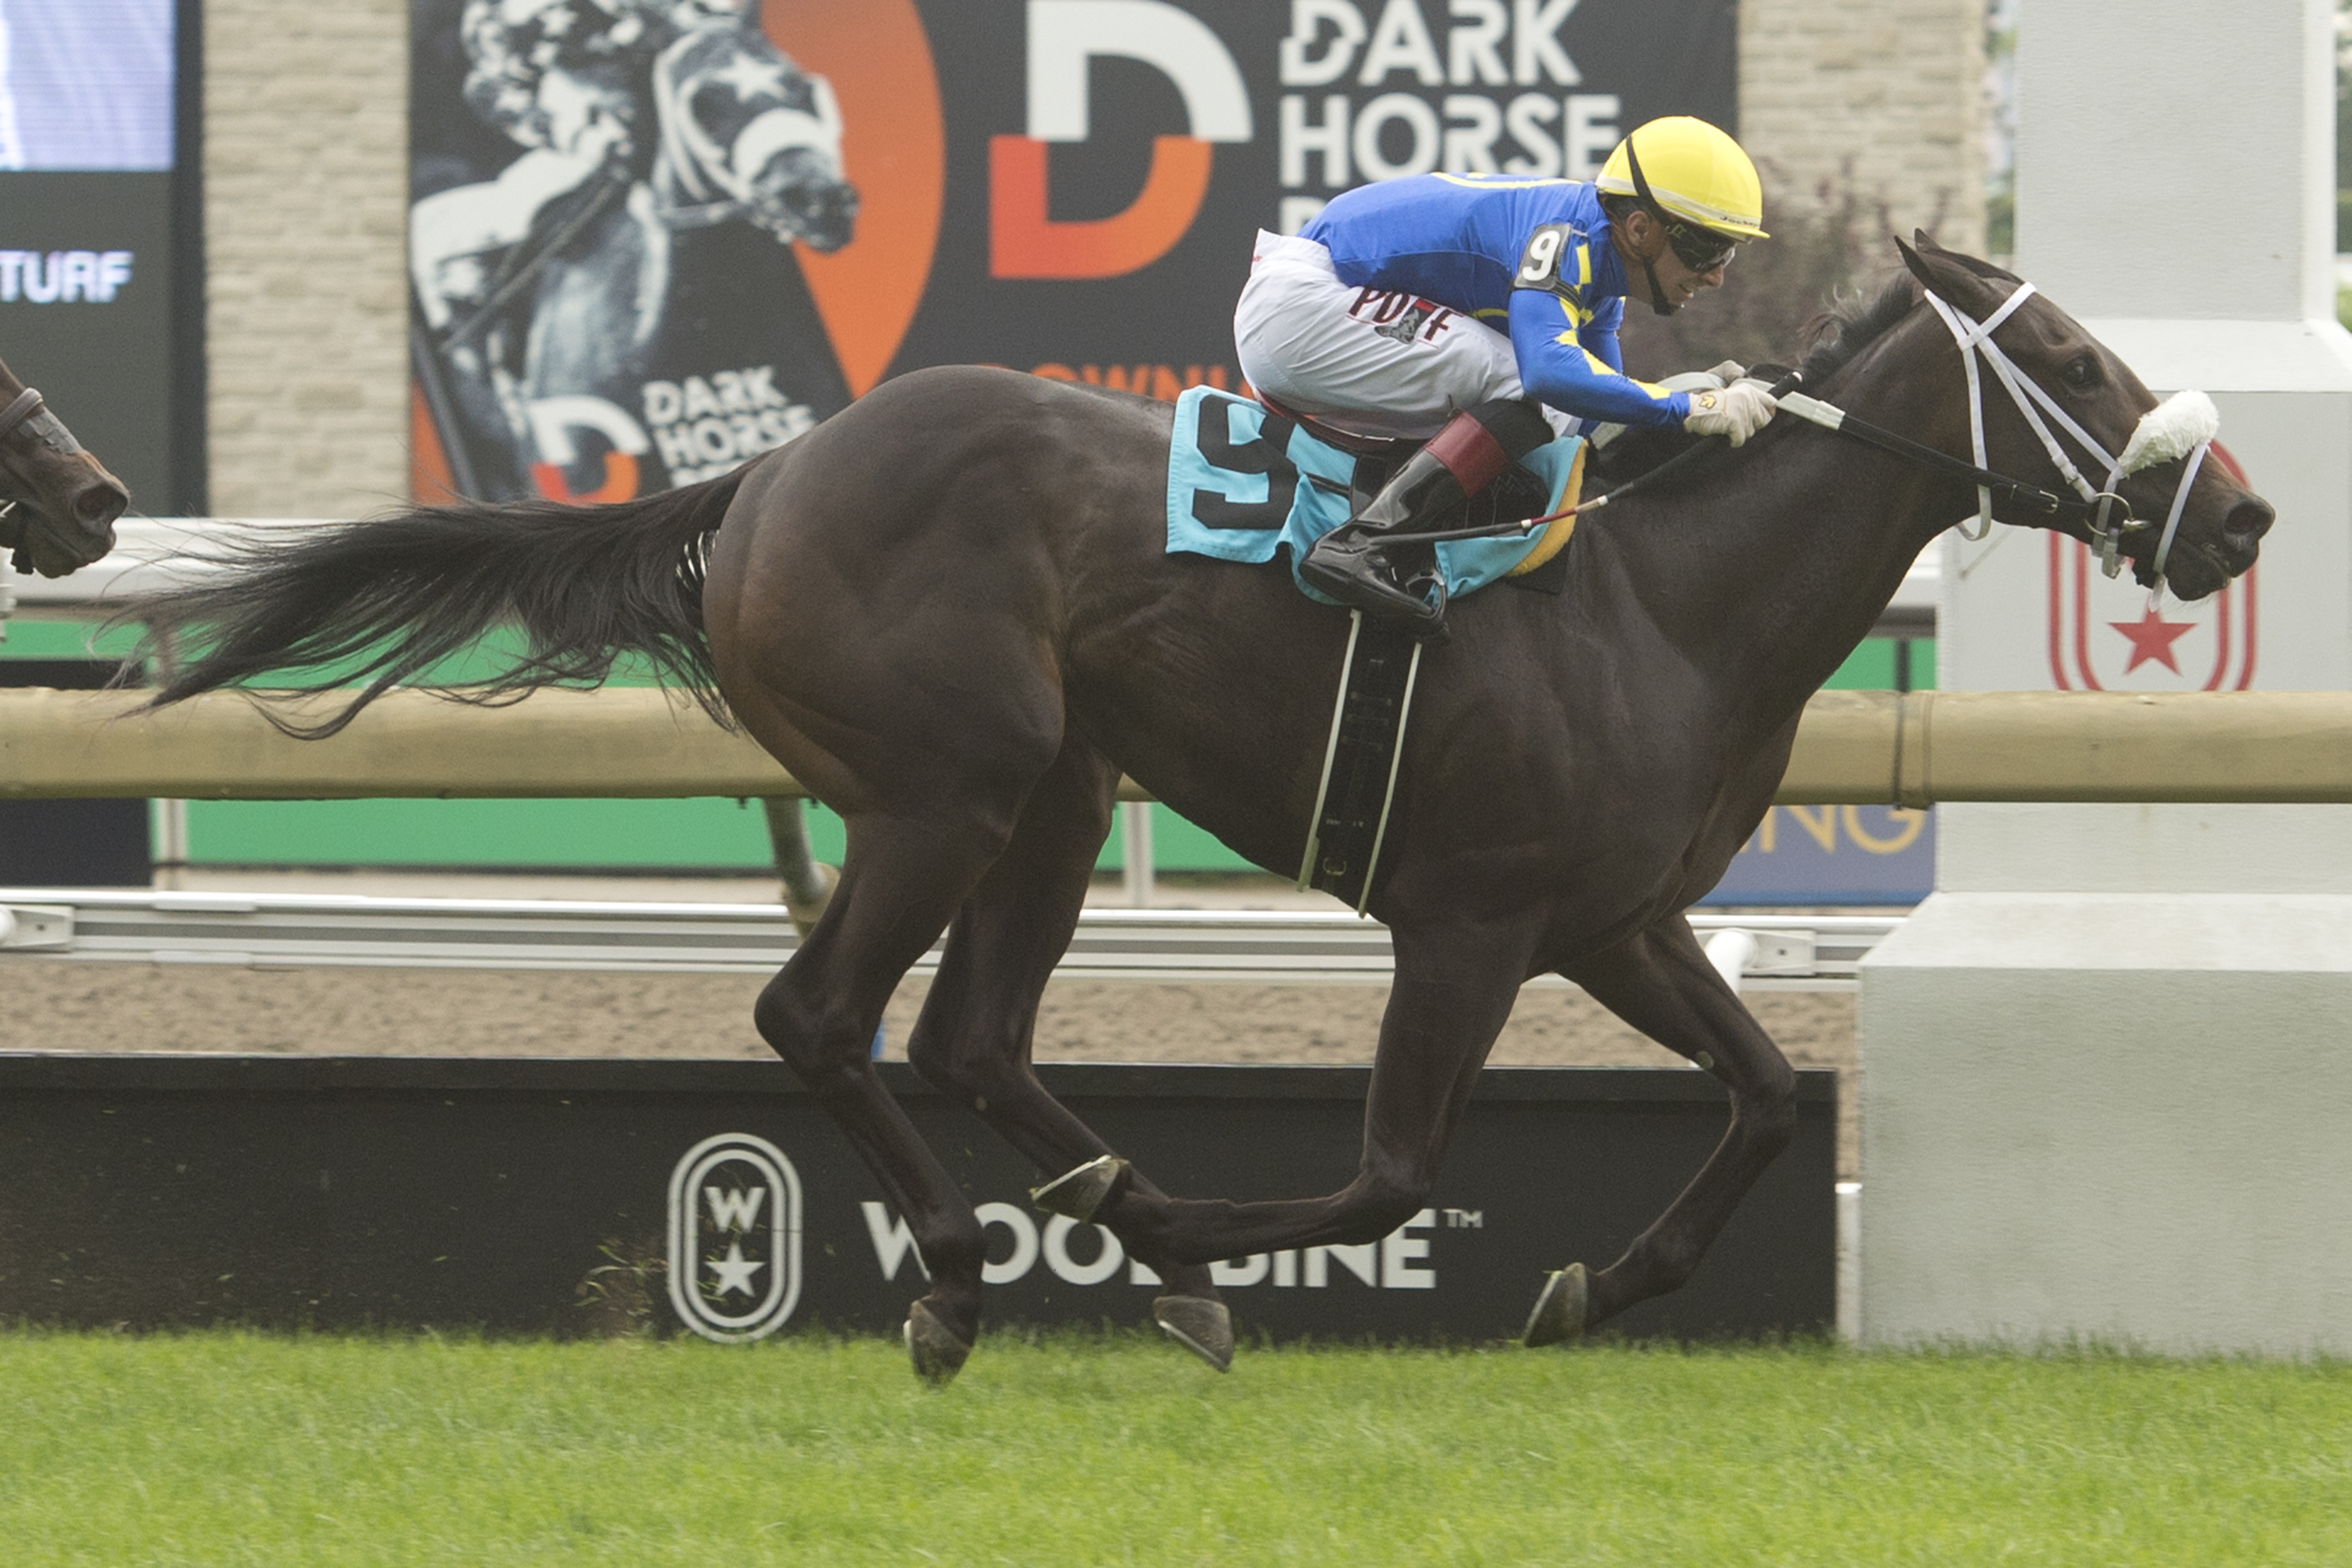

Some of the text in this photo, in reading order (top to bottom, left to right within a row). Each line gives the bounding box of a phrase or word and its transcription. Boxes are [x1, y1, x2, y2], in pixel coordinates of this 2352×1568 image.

[1281, 0, 1582, 86] DARK
[1281, 93, 1622, 187] HORSE
[0, 250, 133, 303] TURF
[1522, 231, 1560, 281] 9
[641, 365, 790, 425] DARK
[655, 404, 817, 468] HORSE
[704, 1186, 766, 1233] W
